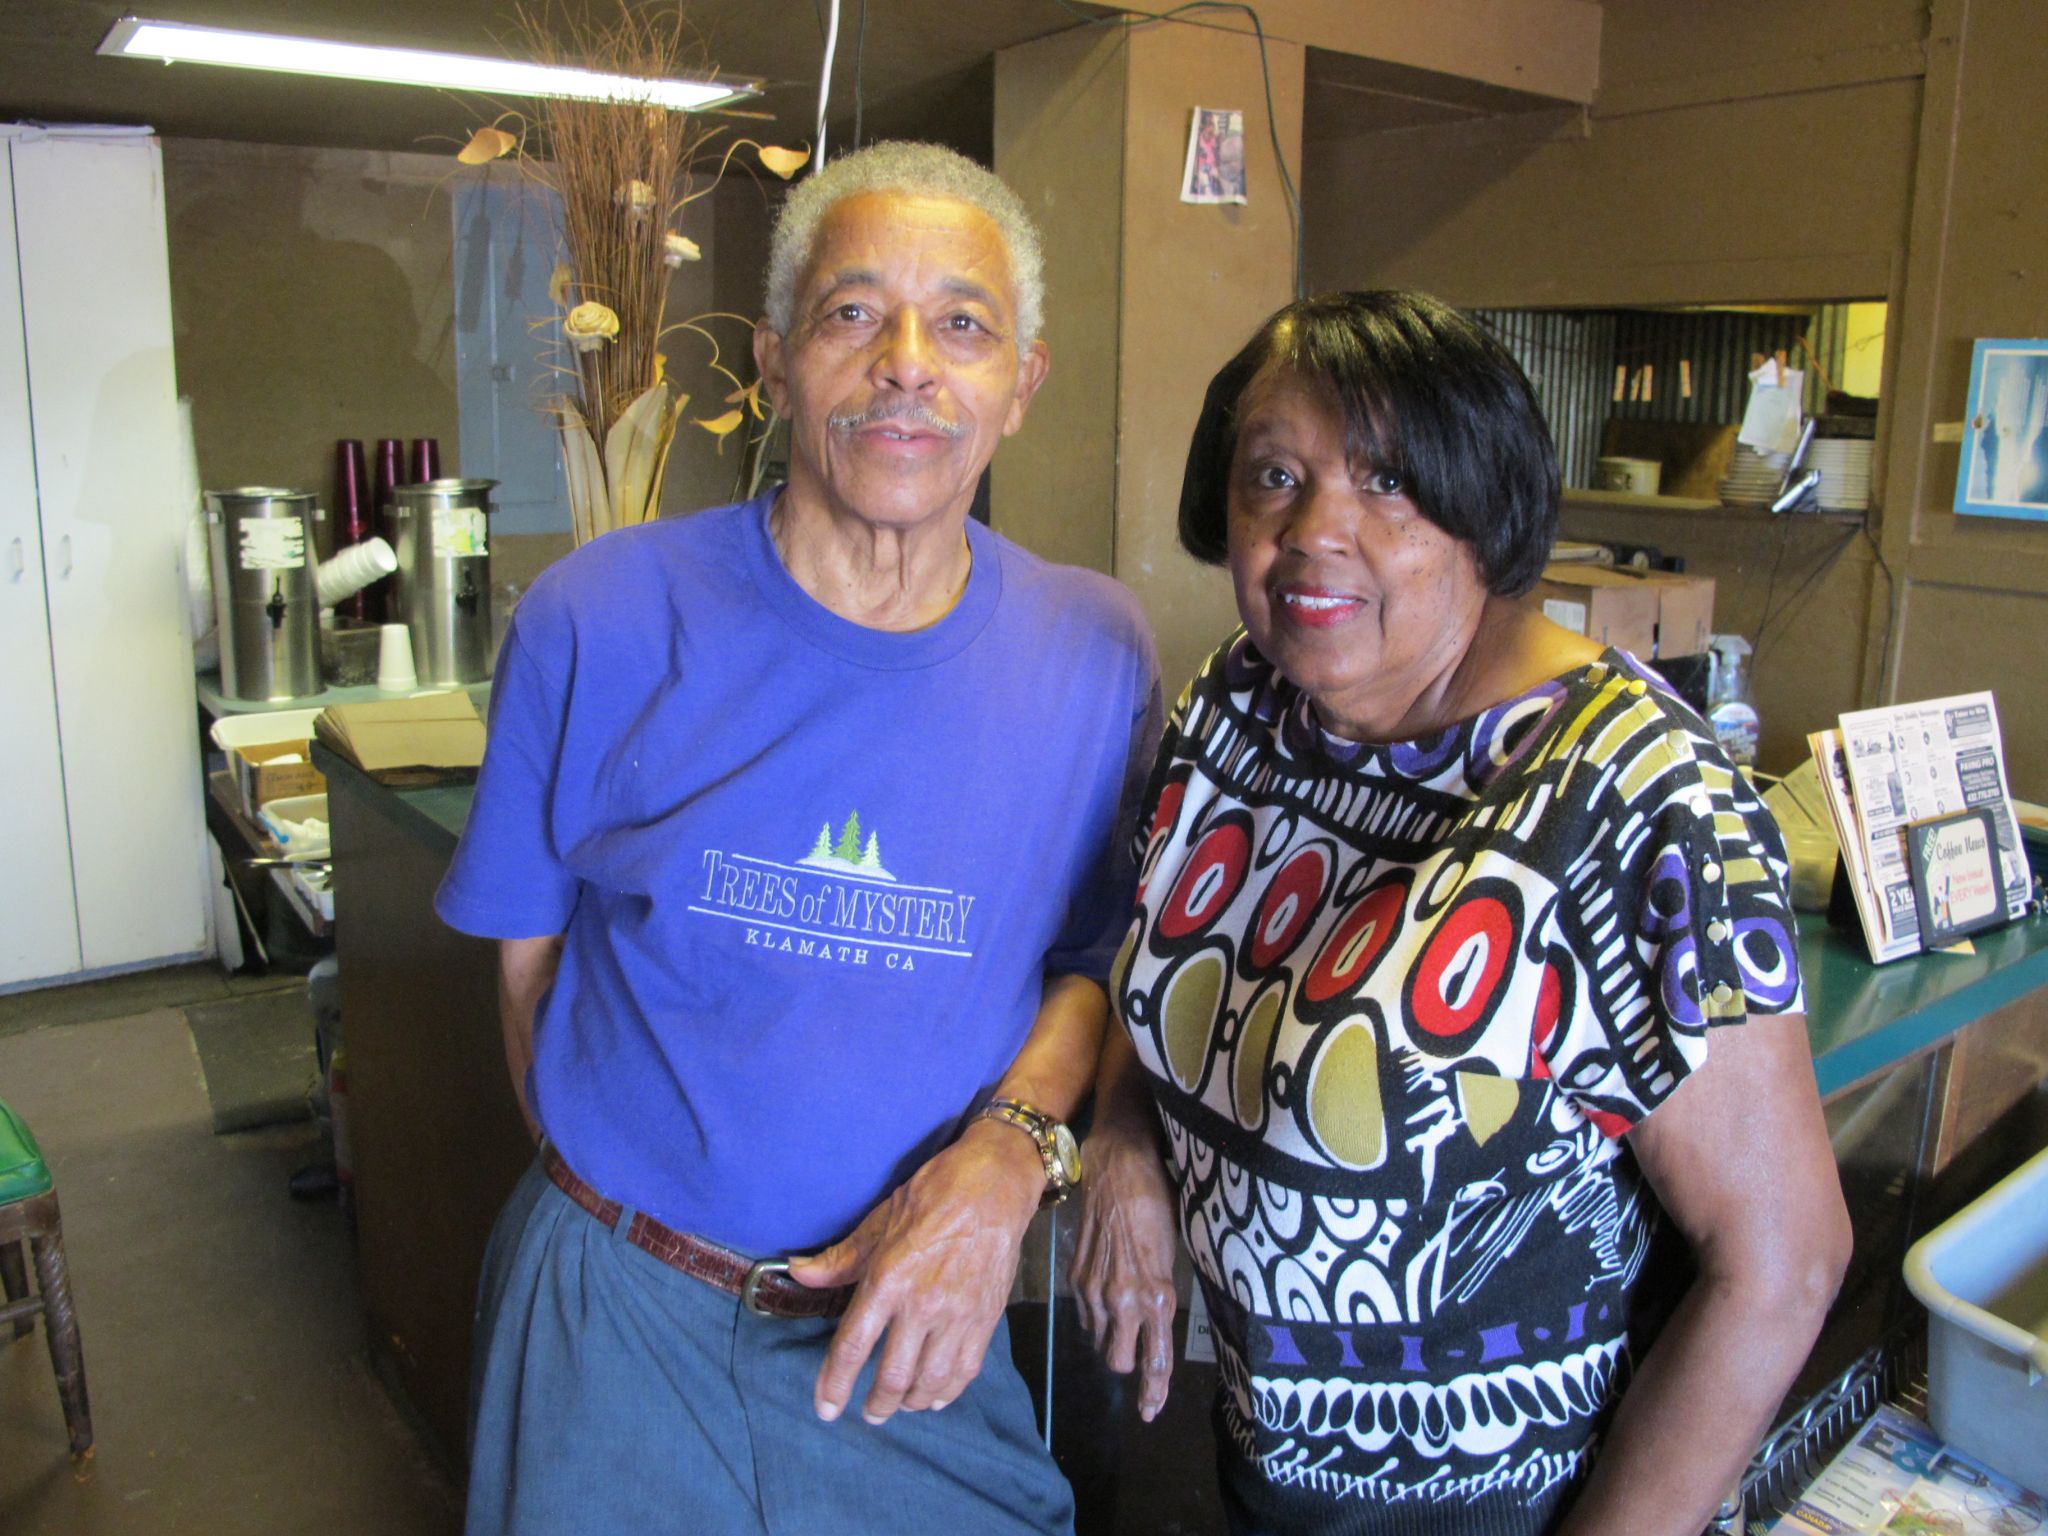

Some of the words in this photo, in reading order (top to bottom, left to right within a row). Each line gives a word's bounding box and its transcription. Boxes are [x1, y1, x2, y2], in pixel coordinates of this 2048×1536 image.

[1936, 841, 1962, 861] Coffee
[1964, 835, 1985, 853] News
[701, 850, 799, 918] TREES
[800, 885, 832, 924] of
[829, 885, 976, 945] MYSTERY
[745, 928, 869, 965] KLAMATH
[885, 952, 916, 971] CA
